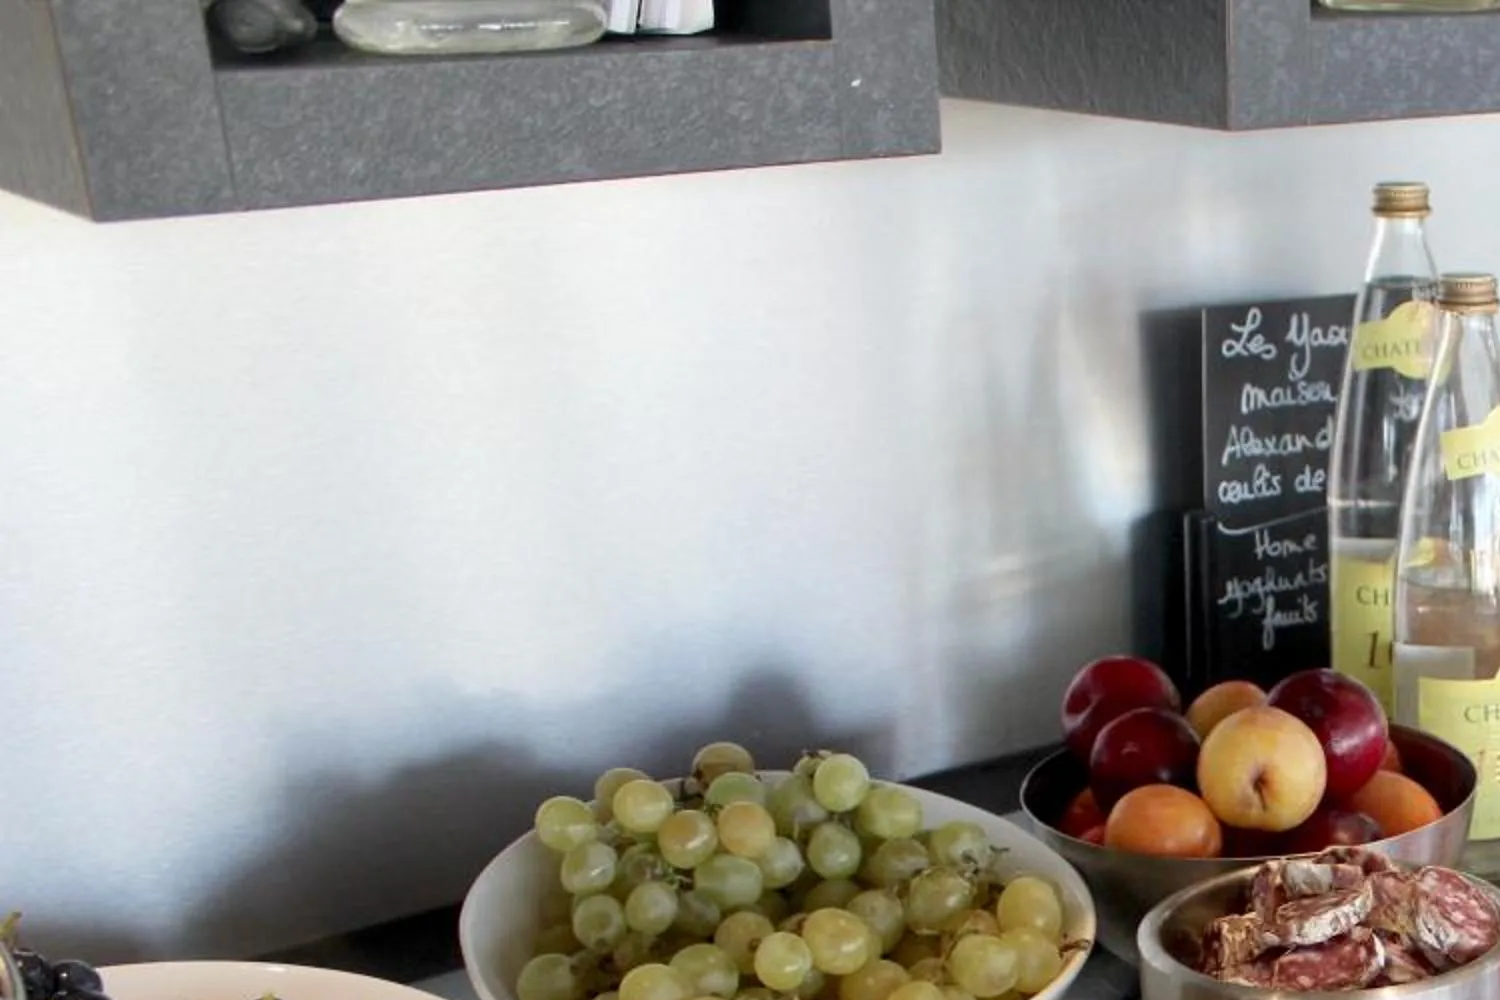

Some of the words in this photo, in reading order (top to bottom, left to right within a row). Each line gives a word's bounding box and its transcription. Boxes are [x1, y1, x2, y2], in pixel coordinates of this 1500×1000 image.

[1221, 306, 1277, 360] Les
[1295, 464, 1326, 493] de
[1254, 528, 1319, 560] Home
